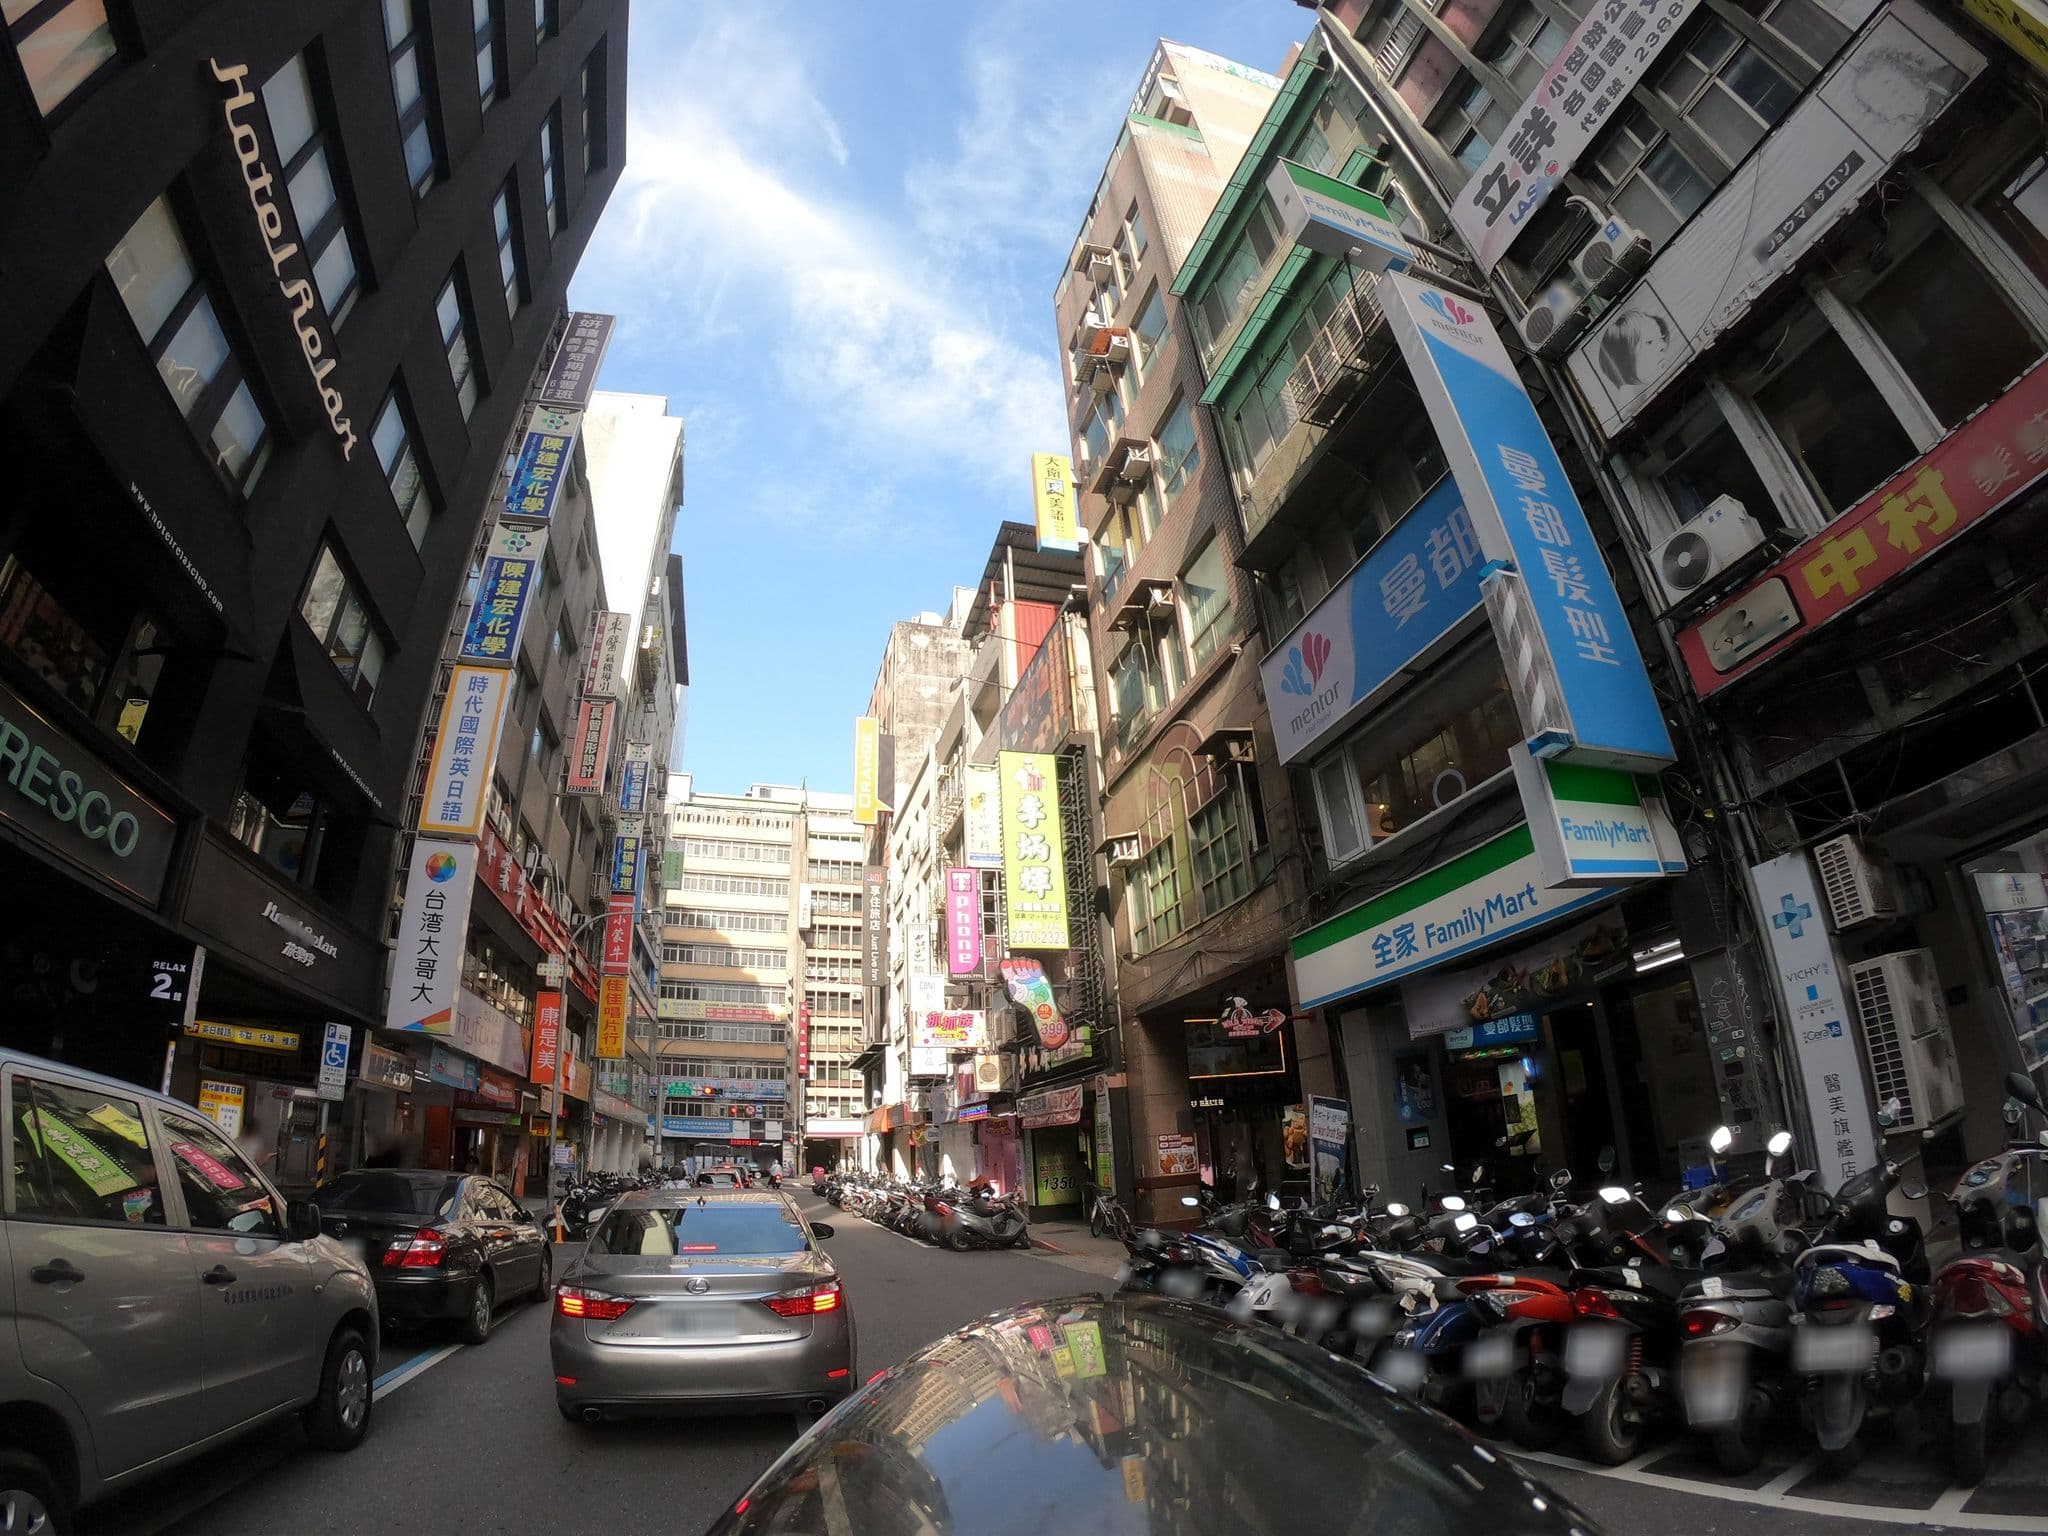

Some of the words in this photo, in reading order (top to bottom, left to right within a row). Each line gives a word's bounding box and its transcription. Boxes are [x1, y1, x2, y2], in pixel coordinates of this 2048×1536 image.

[209, 57, 299, 278] Hotel
[1814, 161, 1851, 202] サロン
[1303, 195, 1401, 242] FamilyMart
[1431, 319, 1485, 345] mentor
[521, 436, 565, 513] 陳建宏化學
[1498, 443, 1622, 667] 曼都髮型
[1800, 464, 1959, 600] 中村
[480, 561, 528, 655] 陳建宏化學
[1290, 680, 1341, 736] mentor
[440, 675, 489, 823] 時代國際英日語
[0, 714, 140, 858] RESCO
[1560, 816, 1652, 849] FamilyMart
[609, 914, 627, 962] 小蒙牛
[1370, 921, 1420, 970] 全家
[1423, 882, 1538, 950] FamilyMart
[152, 960, 188, 973] RELAX
[1786, 965, 1820, 982] VICHY
[328, 1026, 336, 1037] P
[602, 979, 624, 1046] 佳佳唱片行
[1041, 1022, 1063, 1036] 399
[1483, 1013, 1536, 1036] 曼都髮型
[1806, 1021, 1842, 1042] CeraVe
[537, 1007, 560, 1071] 康是美
[1043, 1176, 1077, 1191] 1350
